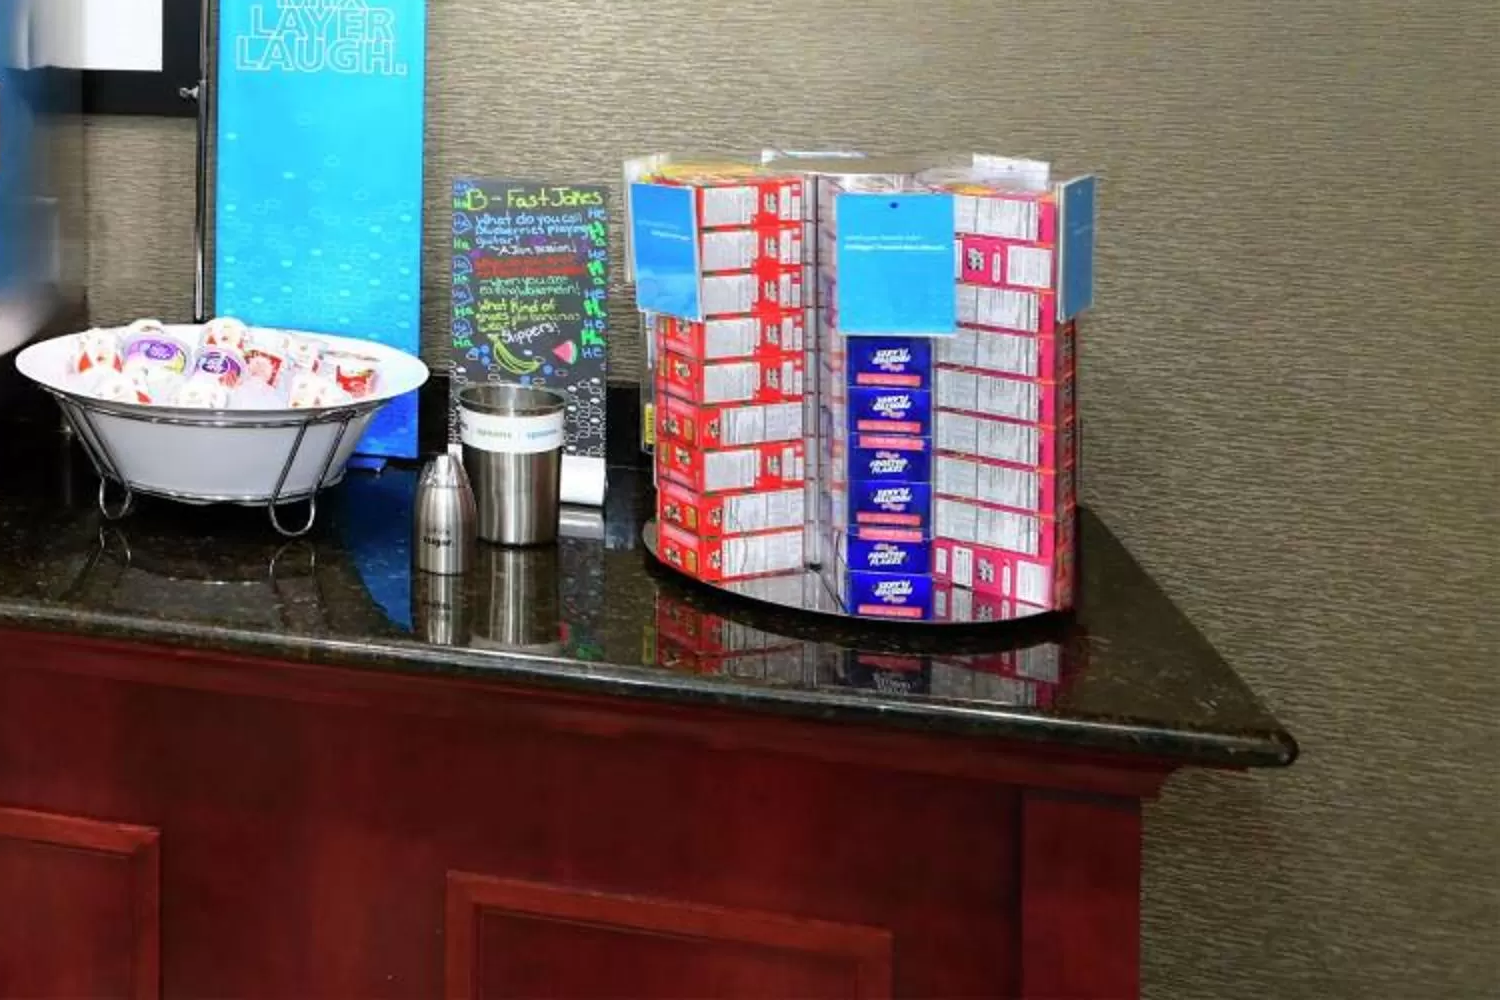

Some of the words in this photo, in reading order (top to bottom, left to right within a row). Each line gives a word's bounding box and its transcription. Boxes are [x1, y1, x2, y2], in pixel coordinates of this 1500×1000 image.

[250, 6, 394, 41] LAYER
[235, 37, 407, 75] LAUGH.
[507, 187, 550, 209] Fast
